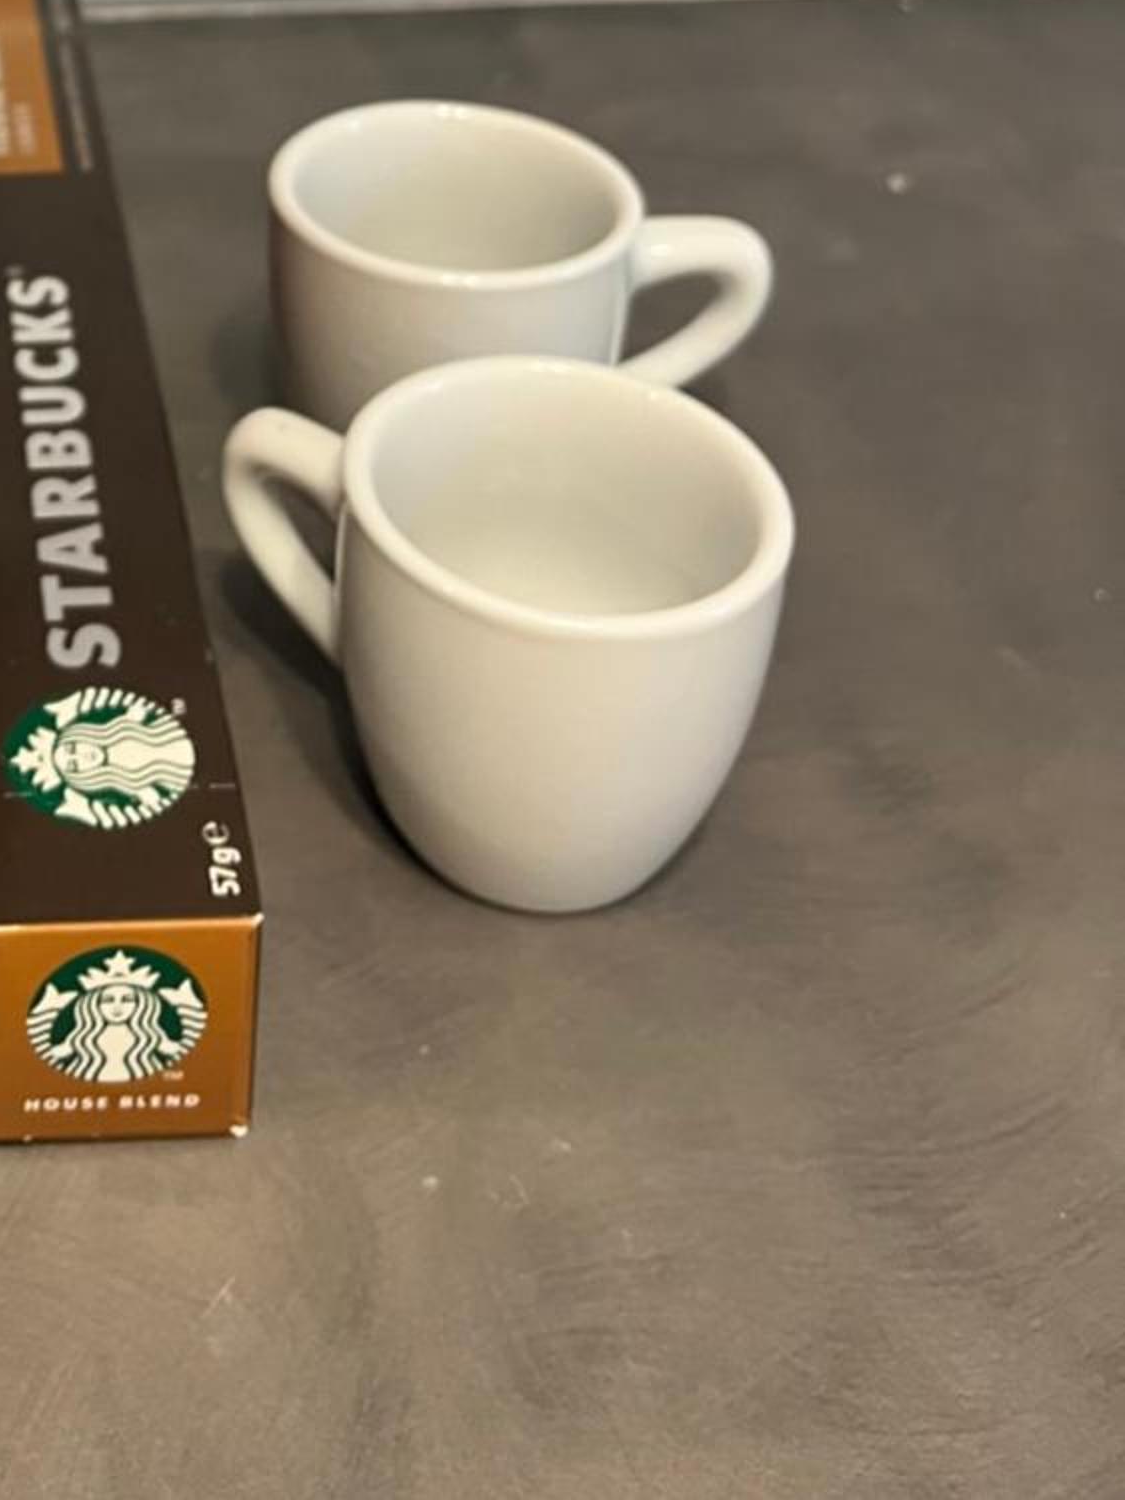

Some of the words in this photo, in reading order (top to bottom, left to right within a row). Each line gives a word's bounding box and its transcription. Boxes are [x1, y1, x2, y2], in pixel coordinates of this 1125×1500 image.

[6, 273, 122, 669] STARBUCKS
[23, 1097, 108, 1113] HOUSE
[119, 1092, 201, 1109] BLEND
